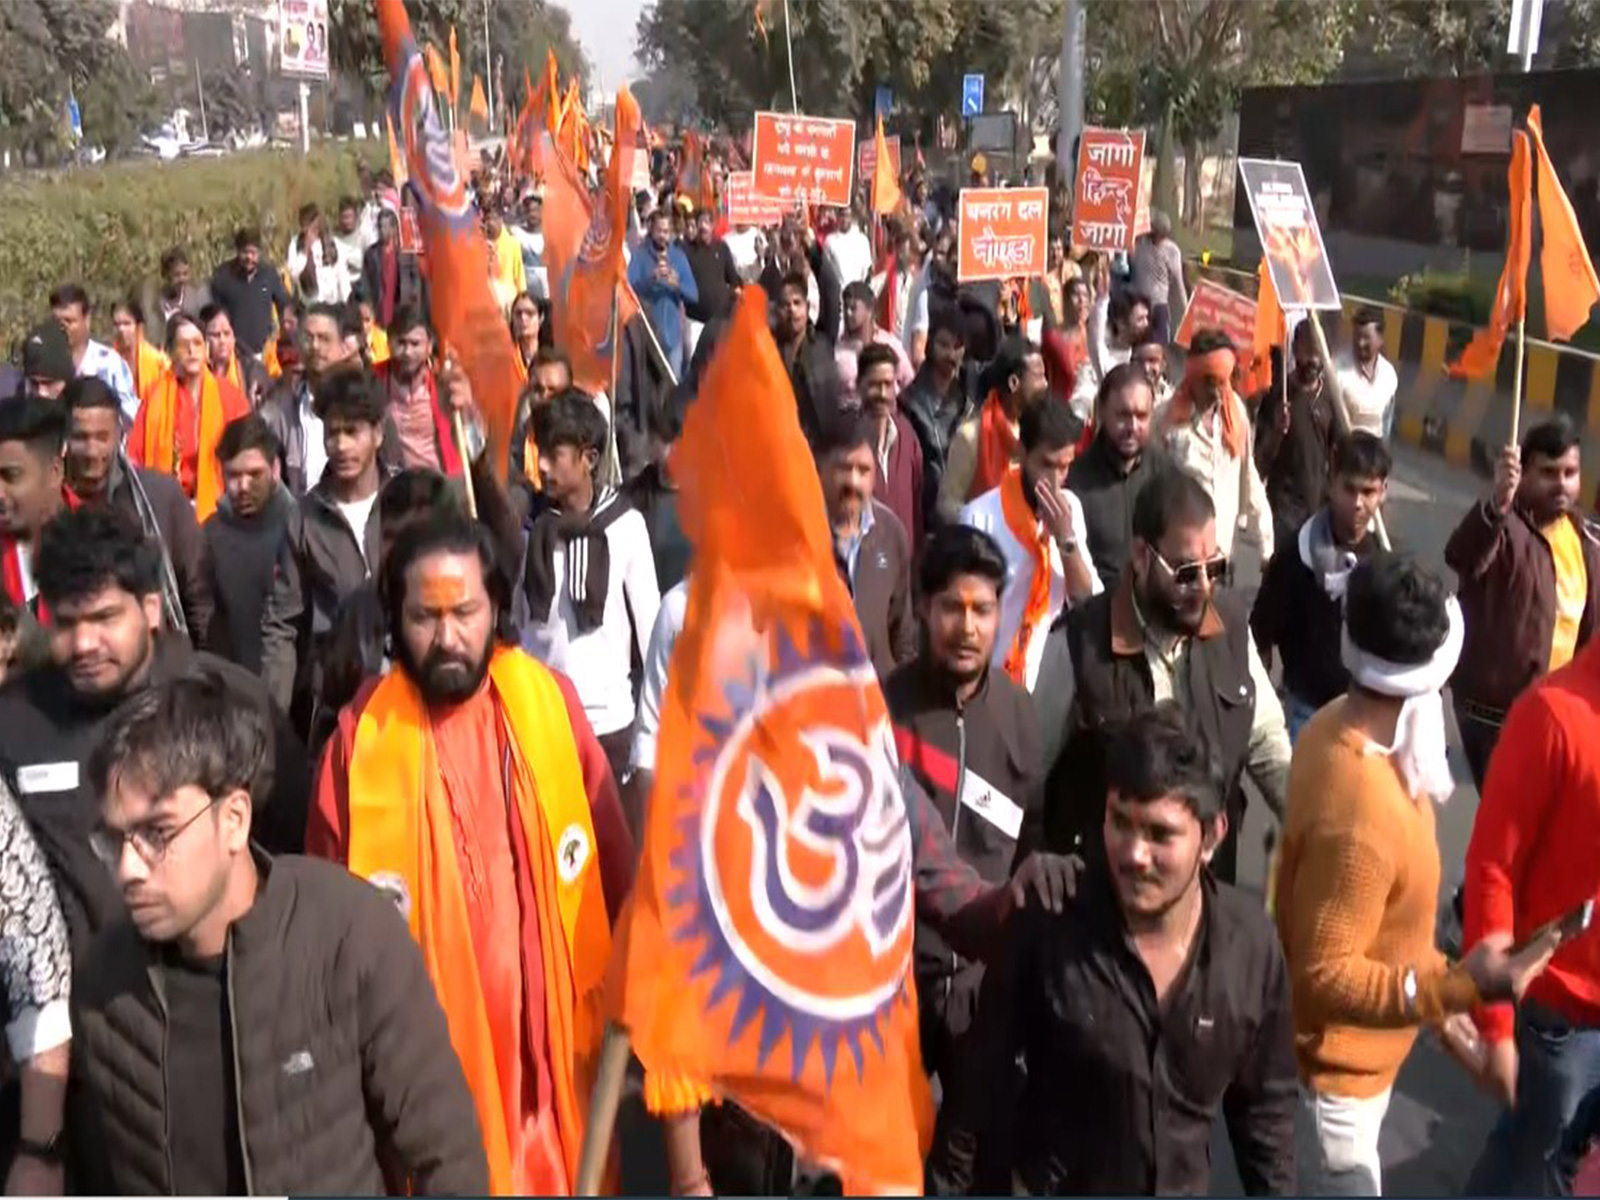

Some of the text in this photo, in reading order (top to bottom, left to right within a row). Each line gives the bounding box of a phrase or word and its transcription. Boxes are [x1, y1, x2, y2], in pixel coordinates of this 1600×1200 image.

[1086, 131, 1137, 168] जागो
[1082, 166, 1133, 215] हिन्दू
[1018, 200, 1043, 221] दल
[1079, 216, 1127, 247] जागो
